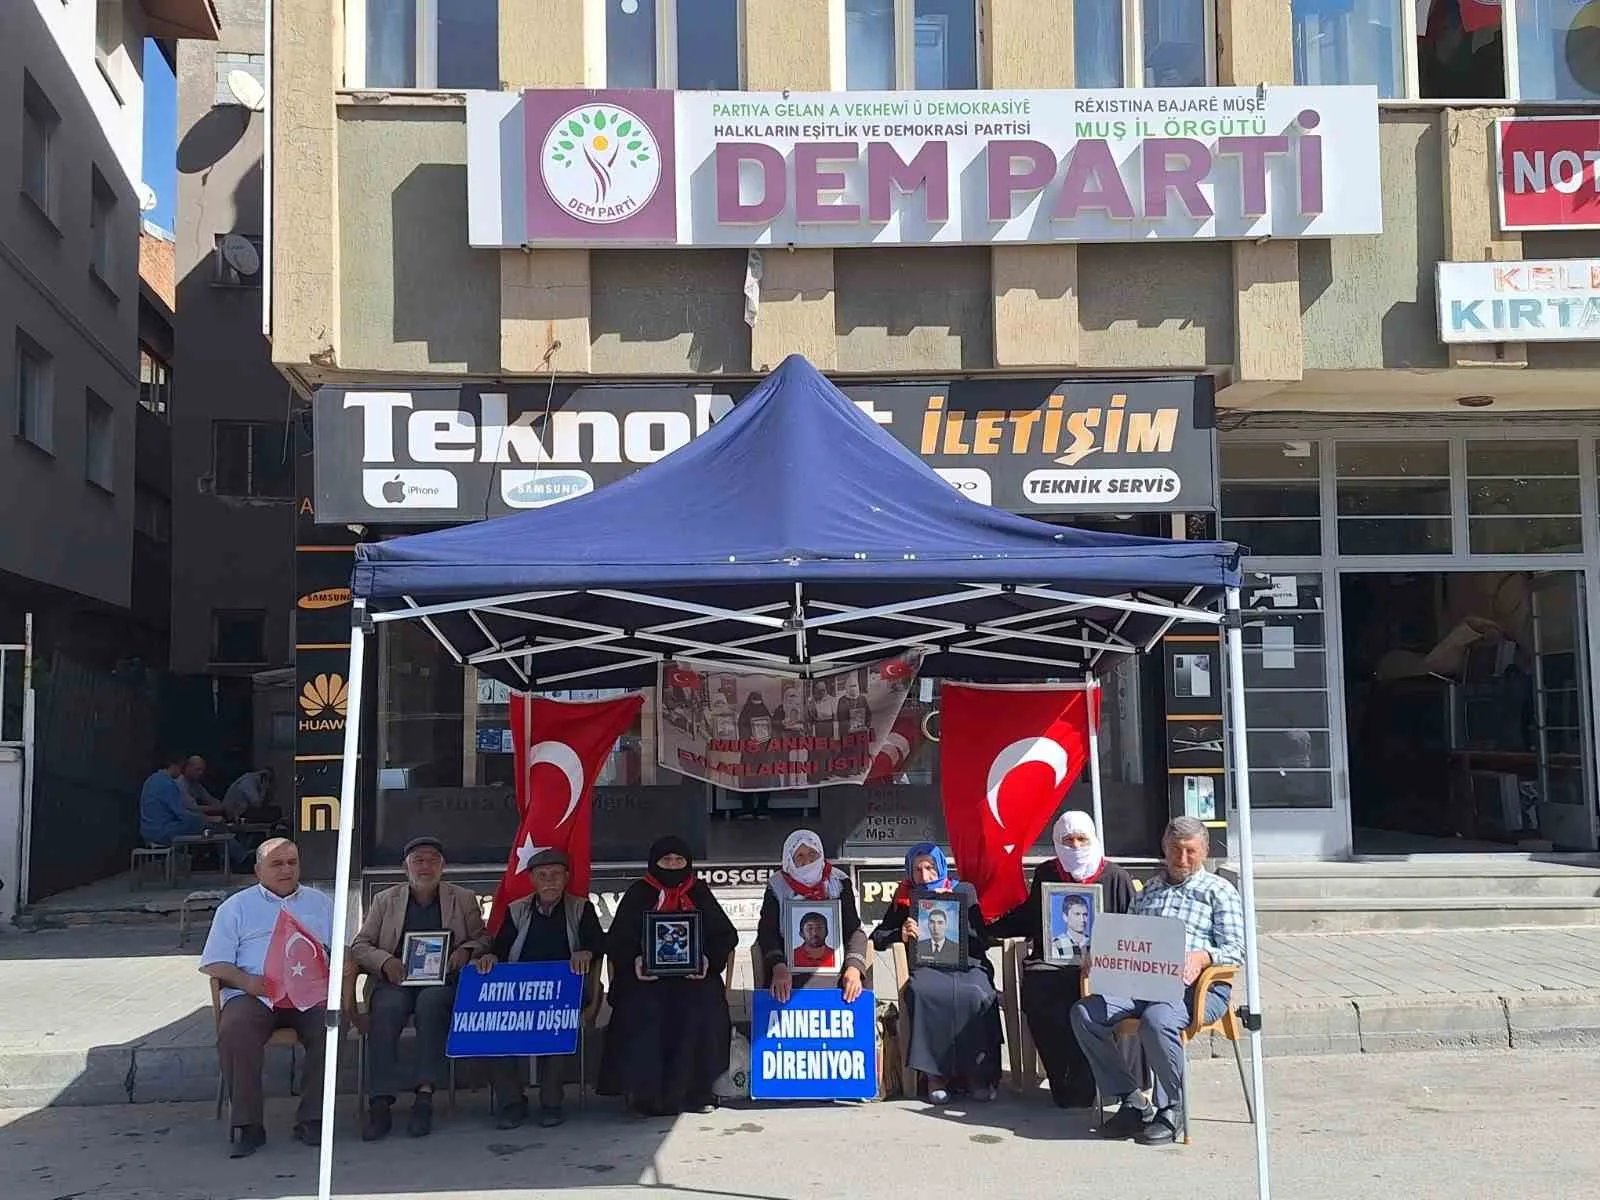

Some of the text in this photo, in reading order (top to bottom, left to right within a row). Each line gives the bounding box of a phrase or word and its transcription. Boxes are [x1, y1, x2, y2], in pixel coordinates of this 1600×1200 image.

[775, 103, 824, 117] GELAN
[829, 103, 840, 117] A
[714, 119, 1031, 139] HALKLARIN EŞİTLİK VE DEMOKRASİ PARTİSİ
[1075, 115, 1266, 140] MUŞ İL ÖRGÜTÜ
[715, 108, 1325, 224] DEM PARTİ
[568, 195, 637, 217] DEM PARTİ
[920, 393, 1181, 467] İLETİŞİM
[407, 483, 440, 497] iPhone
[1029, 474, 1176, 495] TEKNİK SERVİS
[299, 718, 350, 732] HUAW
[866, 815, 917, 826] Telefon
[866, 828, 895, 840] Mp3
[697, 868, 774, 886] HOŞGE
[1117, 939, 1153, 953] EVLAT
[1094, 955, 1180, 977] NÖBETİNDEYİZ
[478, 981, 518, 1003] ARTIK
[519, 980, 555, 1001] YETER
[453, 1003, 580, 1036] YAKAMIZDAN DÜŞÜN
[766, 1009, 855, 1039] ANNELER
[762, 1042, 866, 1081] DİRENİYOR
